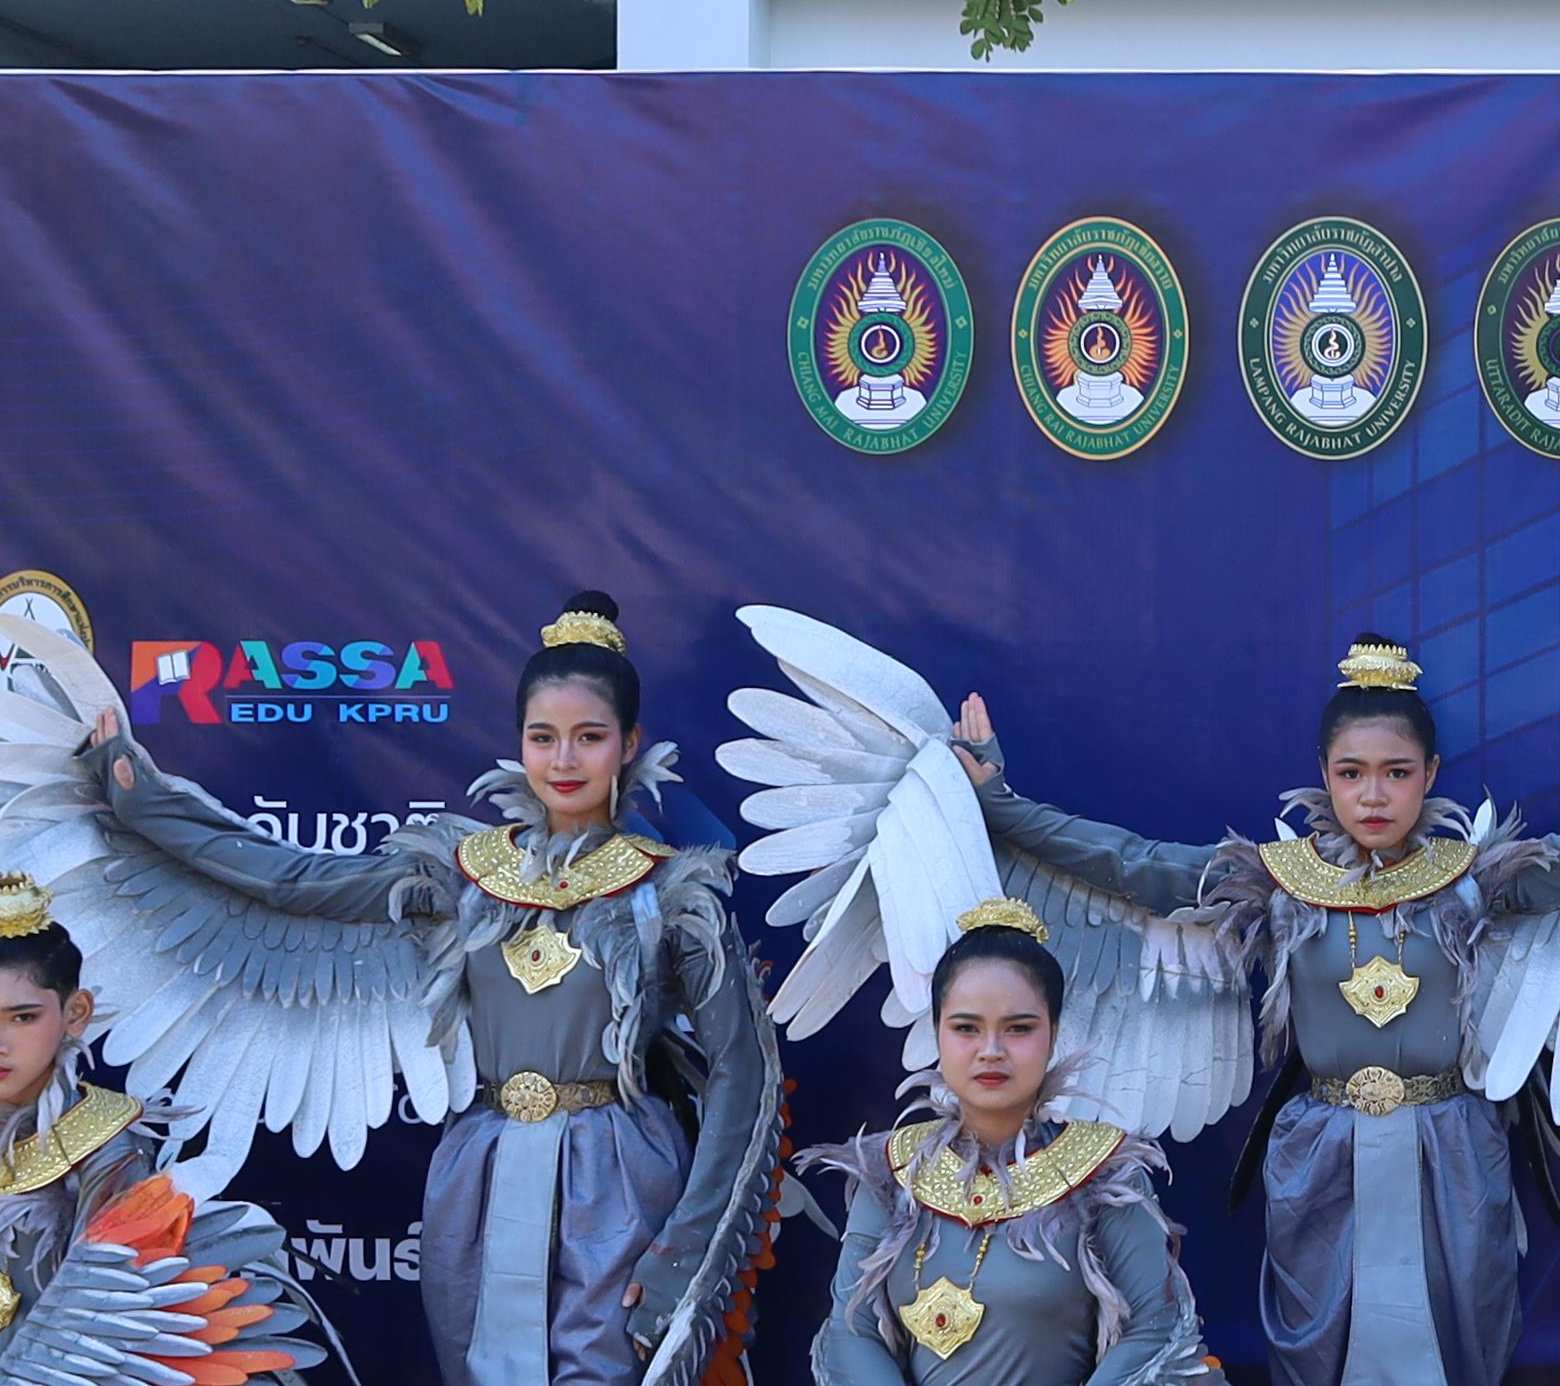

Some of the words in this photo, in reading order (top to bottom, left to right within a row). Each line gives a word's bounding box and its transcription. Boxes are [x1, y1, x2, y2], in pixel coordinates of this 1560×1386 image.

[797, 351, 822, 403] CHIANG
[817, 405, 839, 431] MAI
[843, 428, 919, 449] RAJABHAT
[923, 351, 967, 432] UNIVERSITY
[1020, 365, 1048, 416] CHIANG
[1044, 412, 1064, 435] RAI
[1066, 431, 1131, 449] RAJABHAT
[1133, 365, 1180, 435] UNIVERSITY
[1249, 357, 1287, 424] LAMPANG
[1285, 422, 1362, 449] RAJABHAT
[1365, 359, 1416, 437] UNIVERSITY
[1486, 358, 1532, 432] UTTARADIT
[130, 640, 456, 724] RASSA
[231, 703, 313, 723] EDU
[339, 703, 449, 723] KPRU
